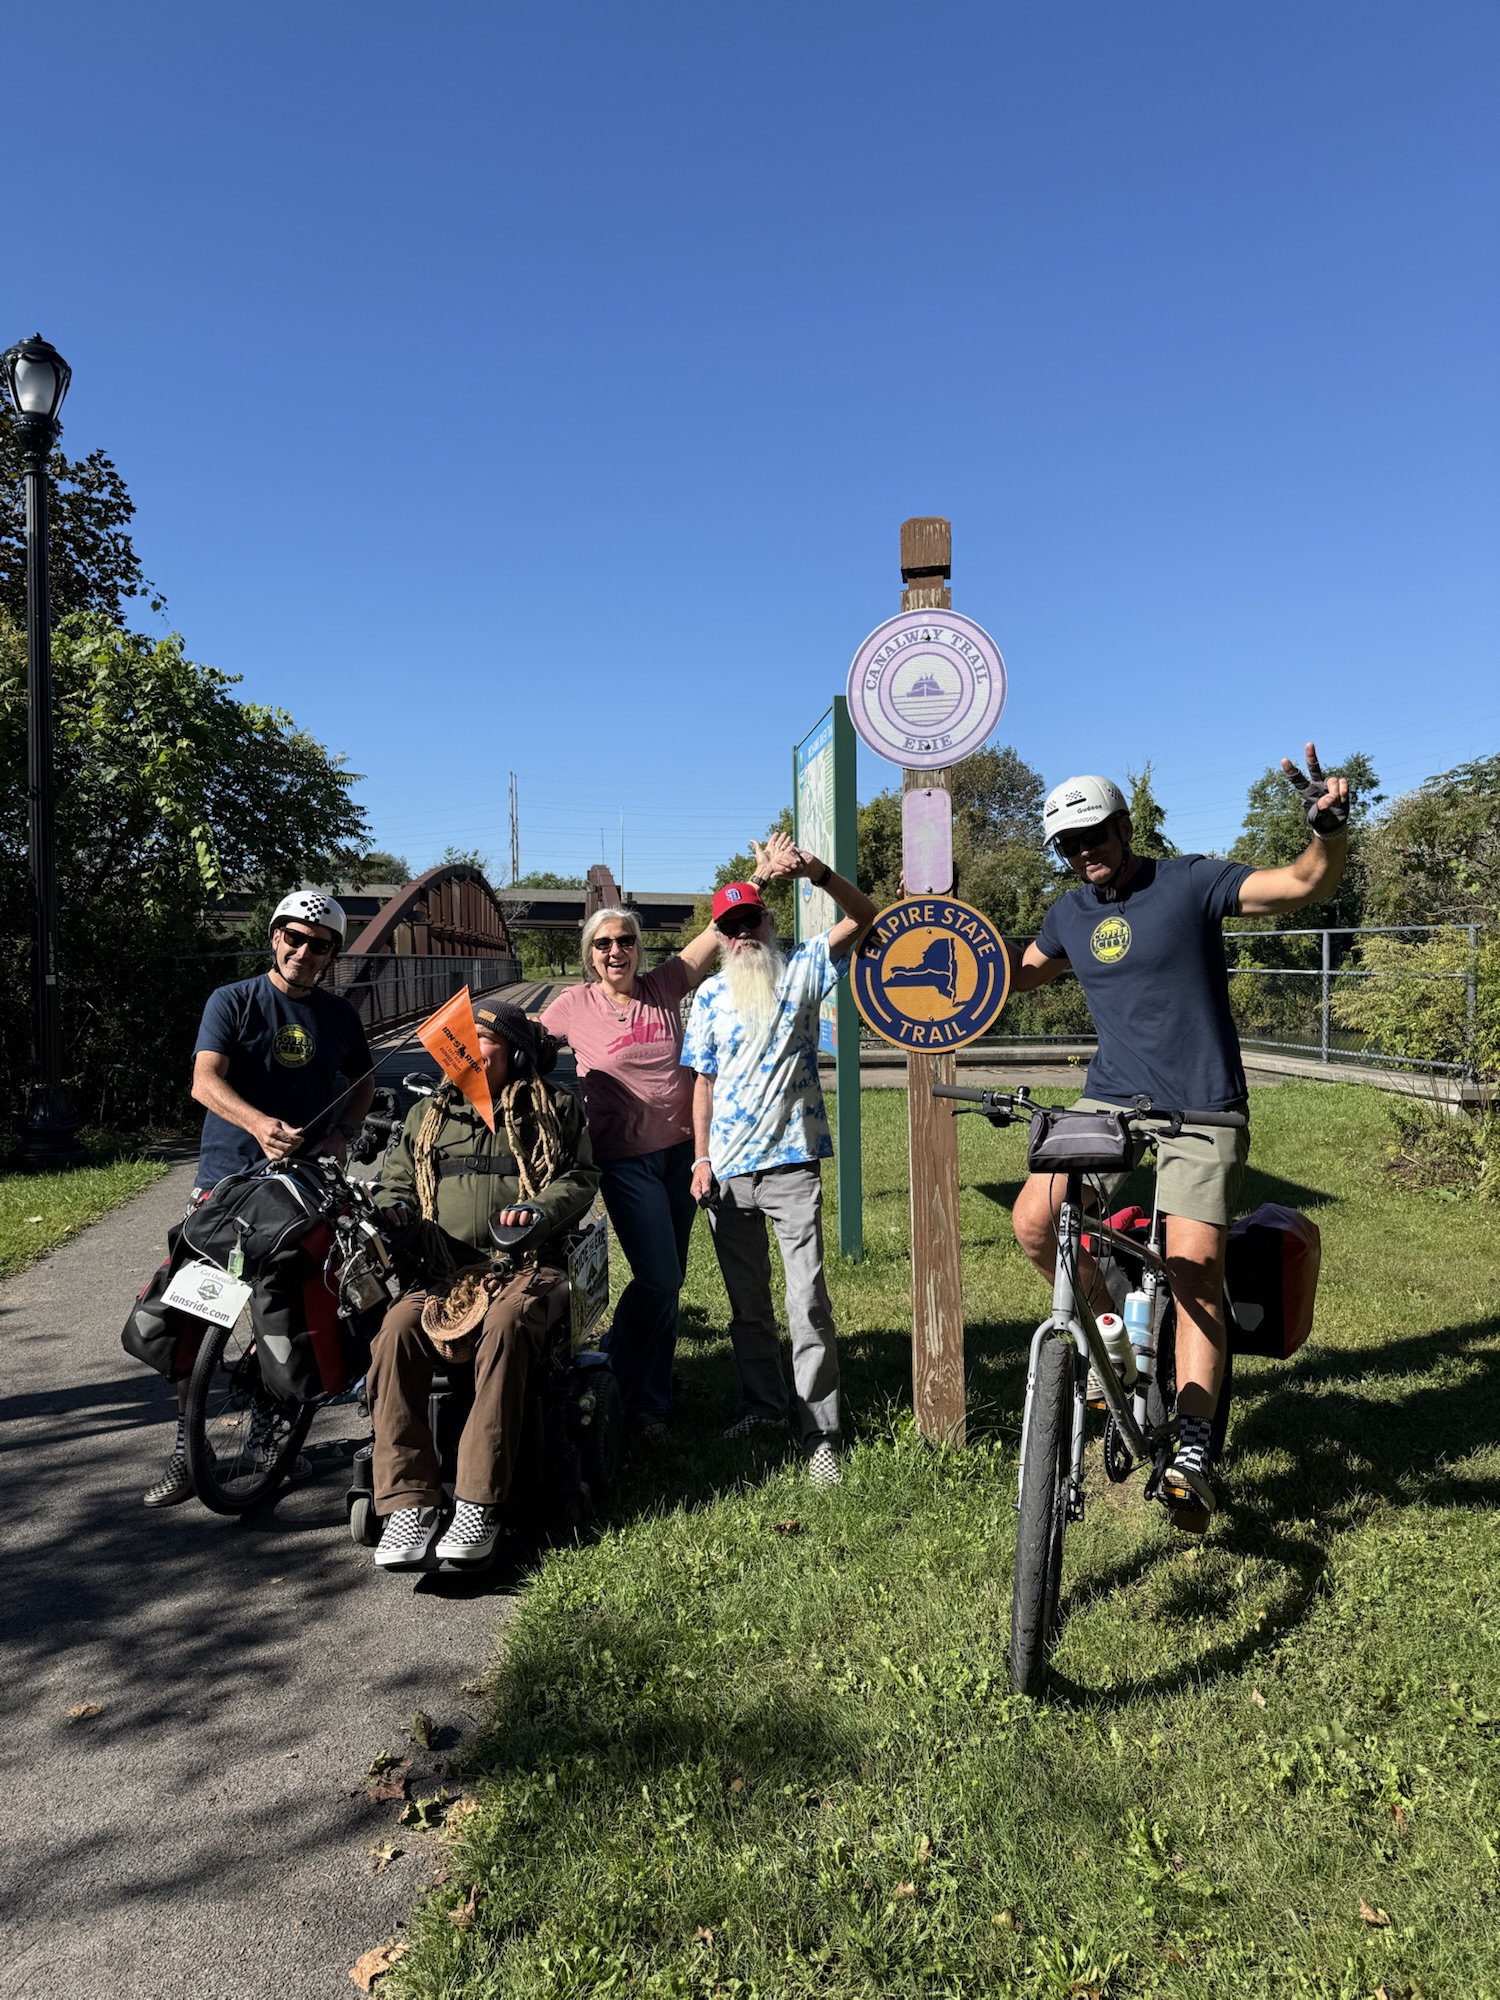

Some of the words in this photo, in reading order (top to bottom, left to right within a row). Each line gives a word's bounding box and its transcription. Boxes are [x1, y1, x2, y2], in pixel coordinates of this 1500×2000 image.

[866, 629, 943, 691] CANALWAY
[951, 633, 988, 684] TRAIL
[903, 734, 952, 751] ERIE
[865, 905, 935, 961] EMPIRE
[941, 907, 996, 958] STATE
[1093, 926, 1129, 941] COPPER
[276, 1034, 314, 1045] COPPER
[899, 1020, 967, 1044] TRAIL
[464, 1054, 483, 1074] RIDE
[169, 1291, 230, 1322] iansride.com
